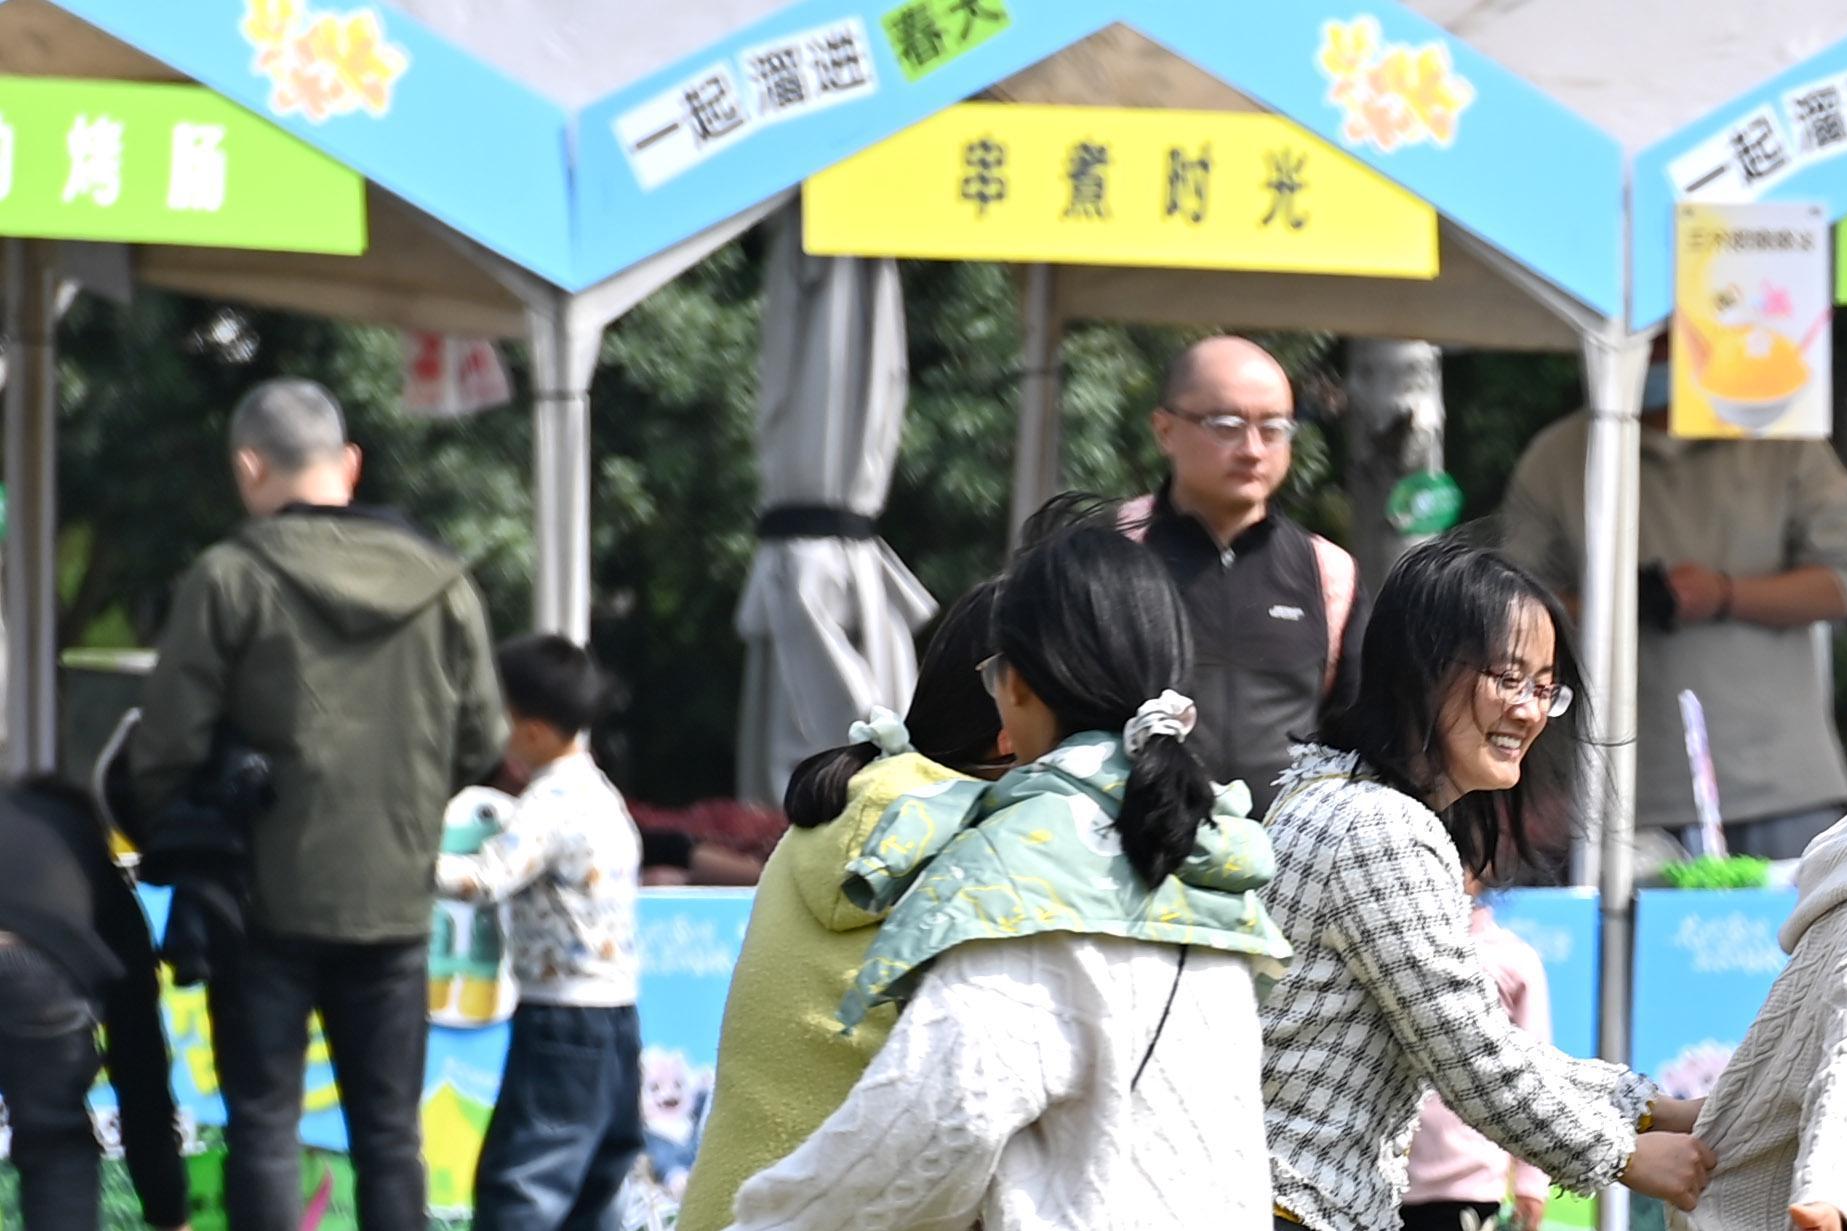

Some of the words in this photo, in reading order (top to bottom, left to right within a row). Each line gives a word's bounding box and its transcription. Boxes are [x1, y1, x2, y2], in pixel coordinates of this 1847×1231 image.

[0, 109, 229, 213] 烤肠
[959, 136, 1307, 231] 串煮时光
